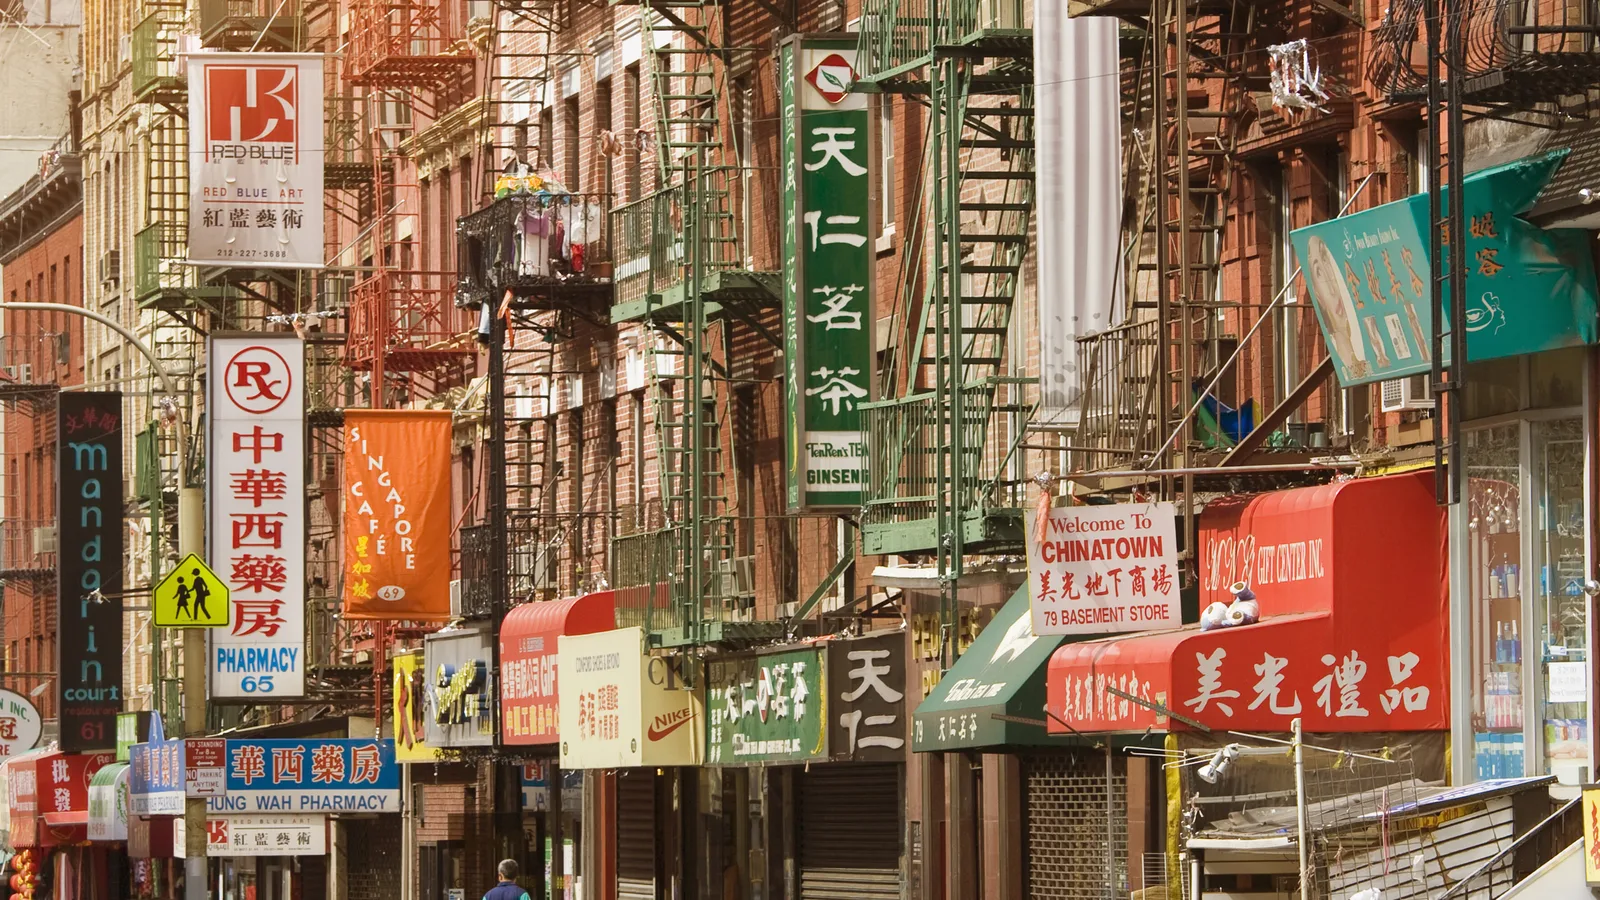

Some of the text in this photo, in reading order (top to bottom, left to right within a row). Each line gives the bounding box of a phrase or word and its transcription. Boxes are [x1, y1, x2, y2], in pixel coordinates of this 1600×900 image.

[212, 144, 294, 160] RED BLUE
[203, 186, 304, 198] RED BLUE ART
[202, 207, 304, 229] 紅藍藝術
[804, 126, 868, 416] 天仁茗茶
[351, 427, 415, 570] SINGAPORE
[351, 481, 386, 555] CAFÉ
[1049, 513, 1152, 535] Welcome To
[229, 424, 288, 637] 中華西藥房
[68, 441, 107, 682] mandarin
[1041, 535, 1163, 564] CHINATOWN
[351, 535, 372, 600] 星加坡
[383, 587, 399, 599] 69
[1037, 563, 1173, 603] 美光地下商場
[1044, 603, 1170, 627] 79 BASEMENT STORE
[217, 647, 298, 673] PHARMACY
[64, 685, 119, 701] court
[241, 675, 274, 693] 65
[1183, 647, 1430, 718] 美光禮品
[10, 700, 31, 723] INC.
[64, 707, 119, 716] restaurant
[840, 649, 905, 755] 天仁
[80, 721, 104, 740] 61
[654, 707, 691, 730] NIKE
[937, 712, 978, 742] 天仁茗茶
[915, 719, 924, 743] 79
[186, 769, 197, 780] NO
[231, 743, 383, 786] 華西藥房
[51, 758, 72, 812] 批發
[206, 794, 388, 811] HUNG WAH PHARMACY
[233, 831, 312, 846] 紅藍藝術
